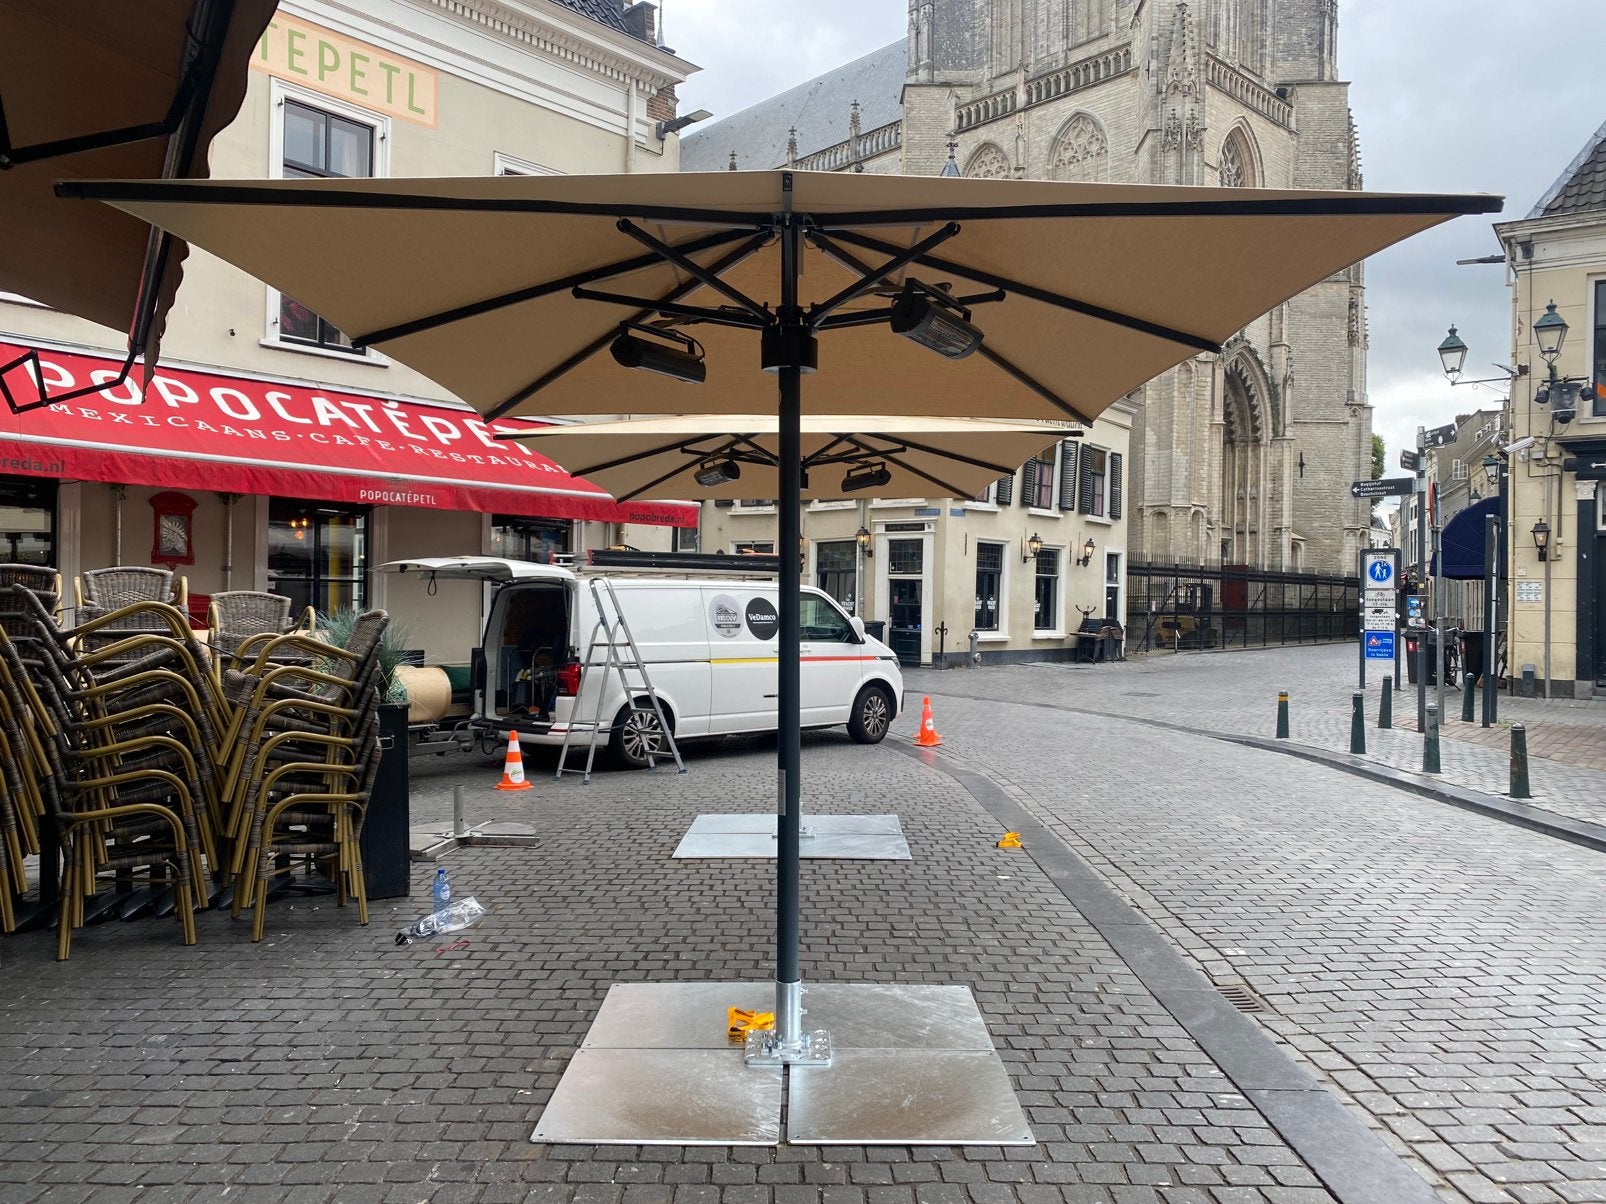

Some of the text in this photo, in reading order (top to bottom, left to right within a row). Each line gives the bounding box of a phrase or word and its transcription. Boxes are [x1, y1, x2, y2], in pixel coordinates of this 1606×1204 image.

[0, 457, 65, 473] reda.nl
[629, 512, 685, 524] popobreda.nl
[748, 613, 777, 621] VeDamco
